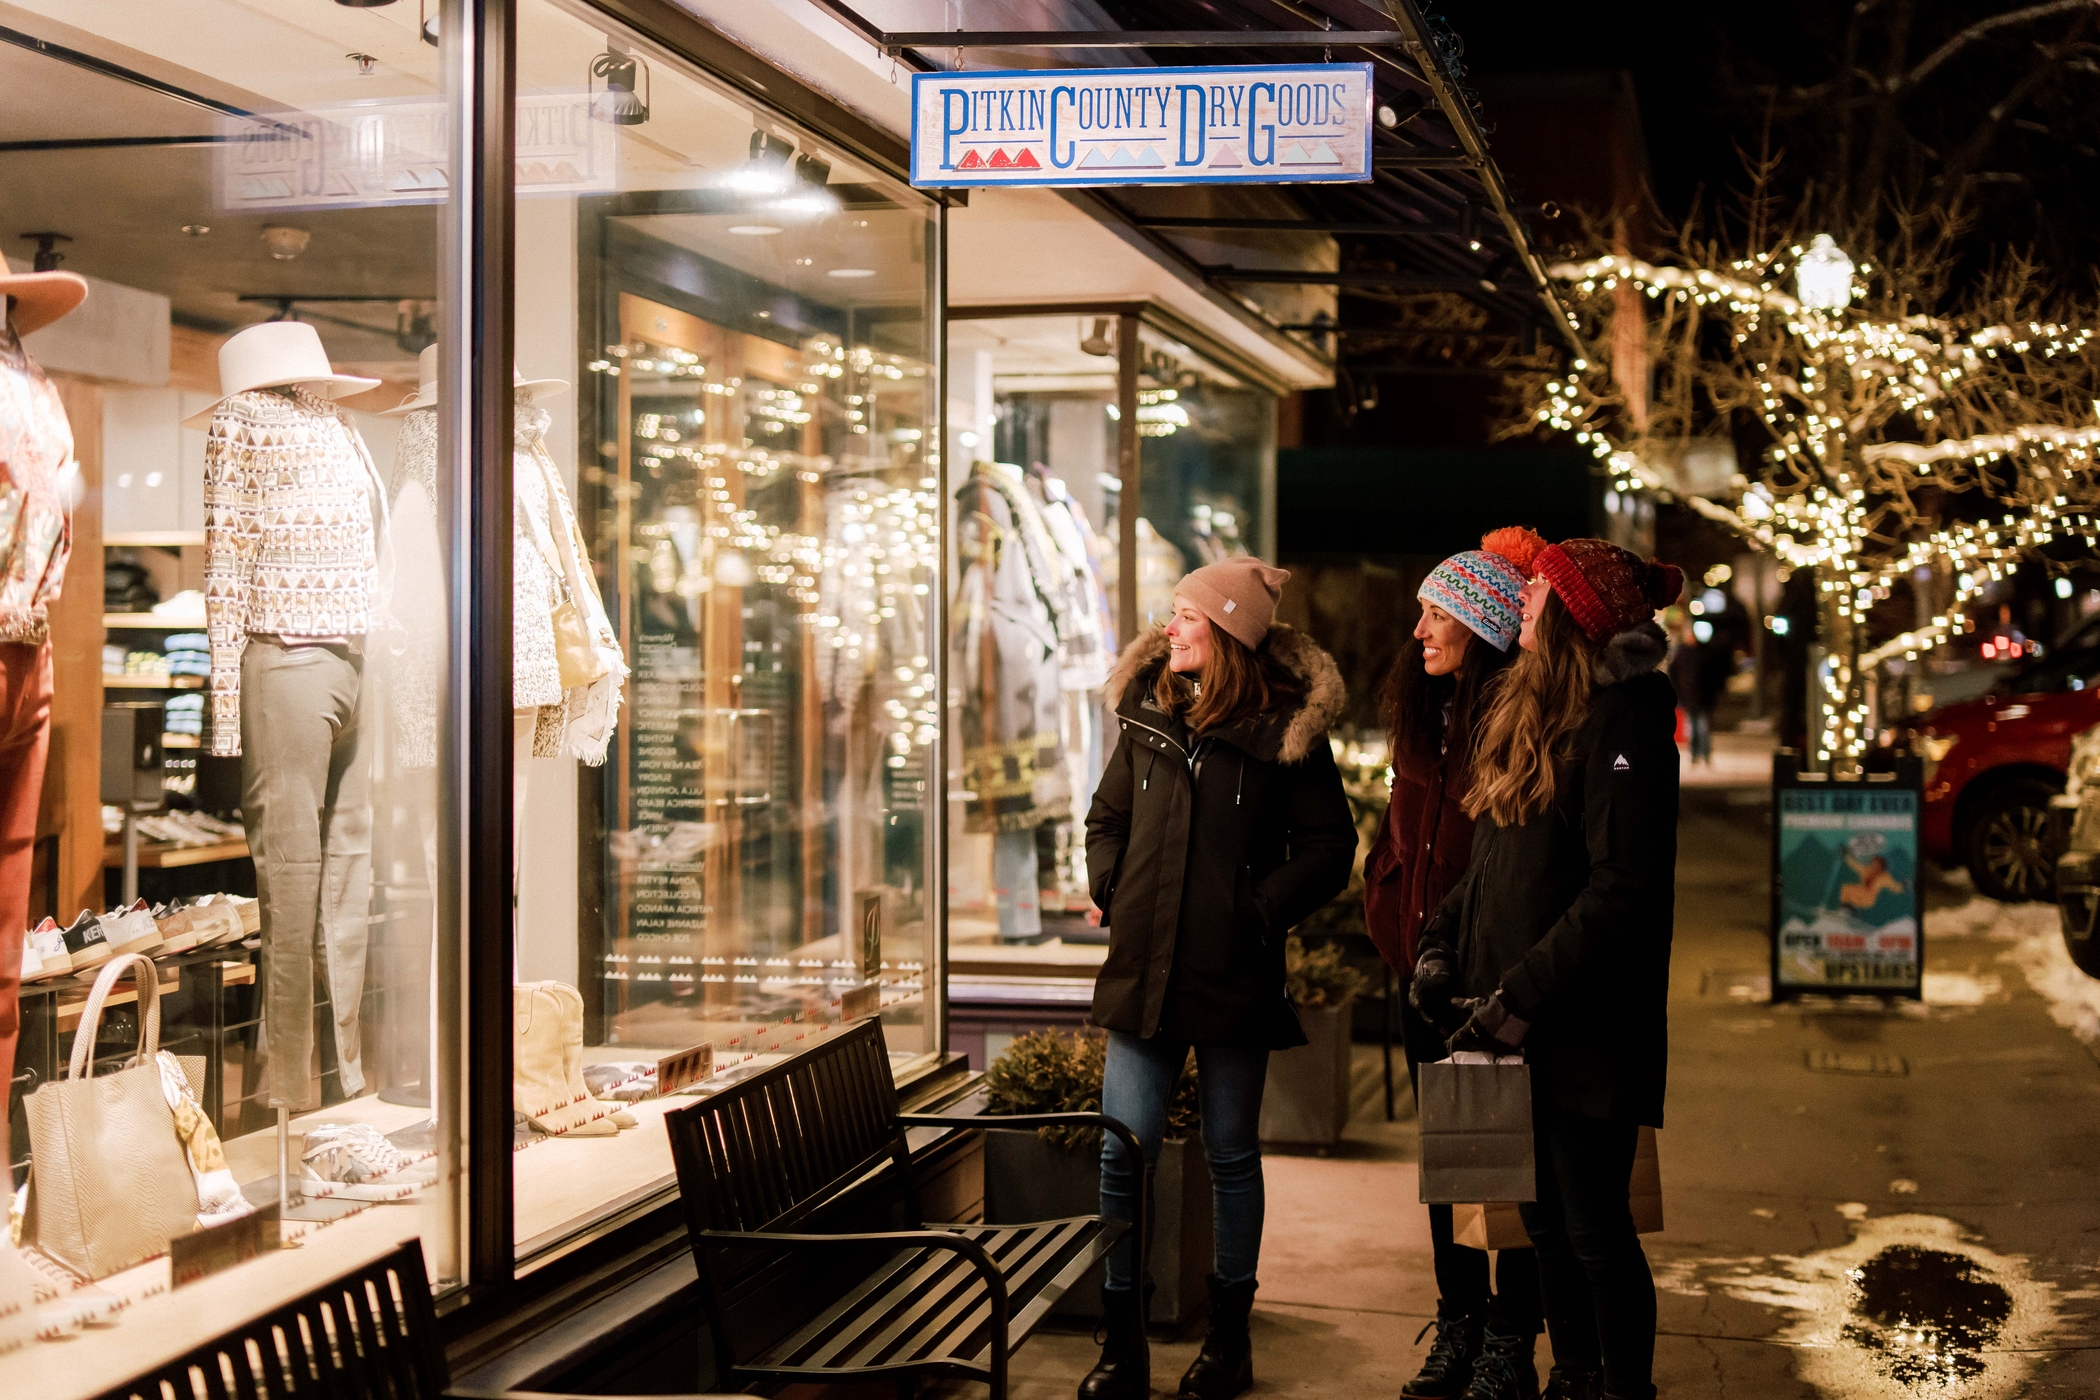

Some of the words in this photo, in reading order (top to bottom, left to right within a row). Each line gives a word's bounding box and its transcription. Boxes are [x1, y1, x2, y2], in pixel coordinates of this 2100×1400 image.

[940, 88, 1044, 170] PITKIN
[1050, 86, 1172, 169] COUNTY
[1175, 84, 1245, 167] DRY
[1248, 82, 1346, 166] GOODS
